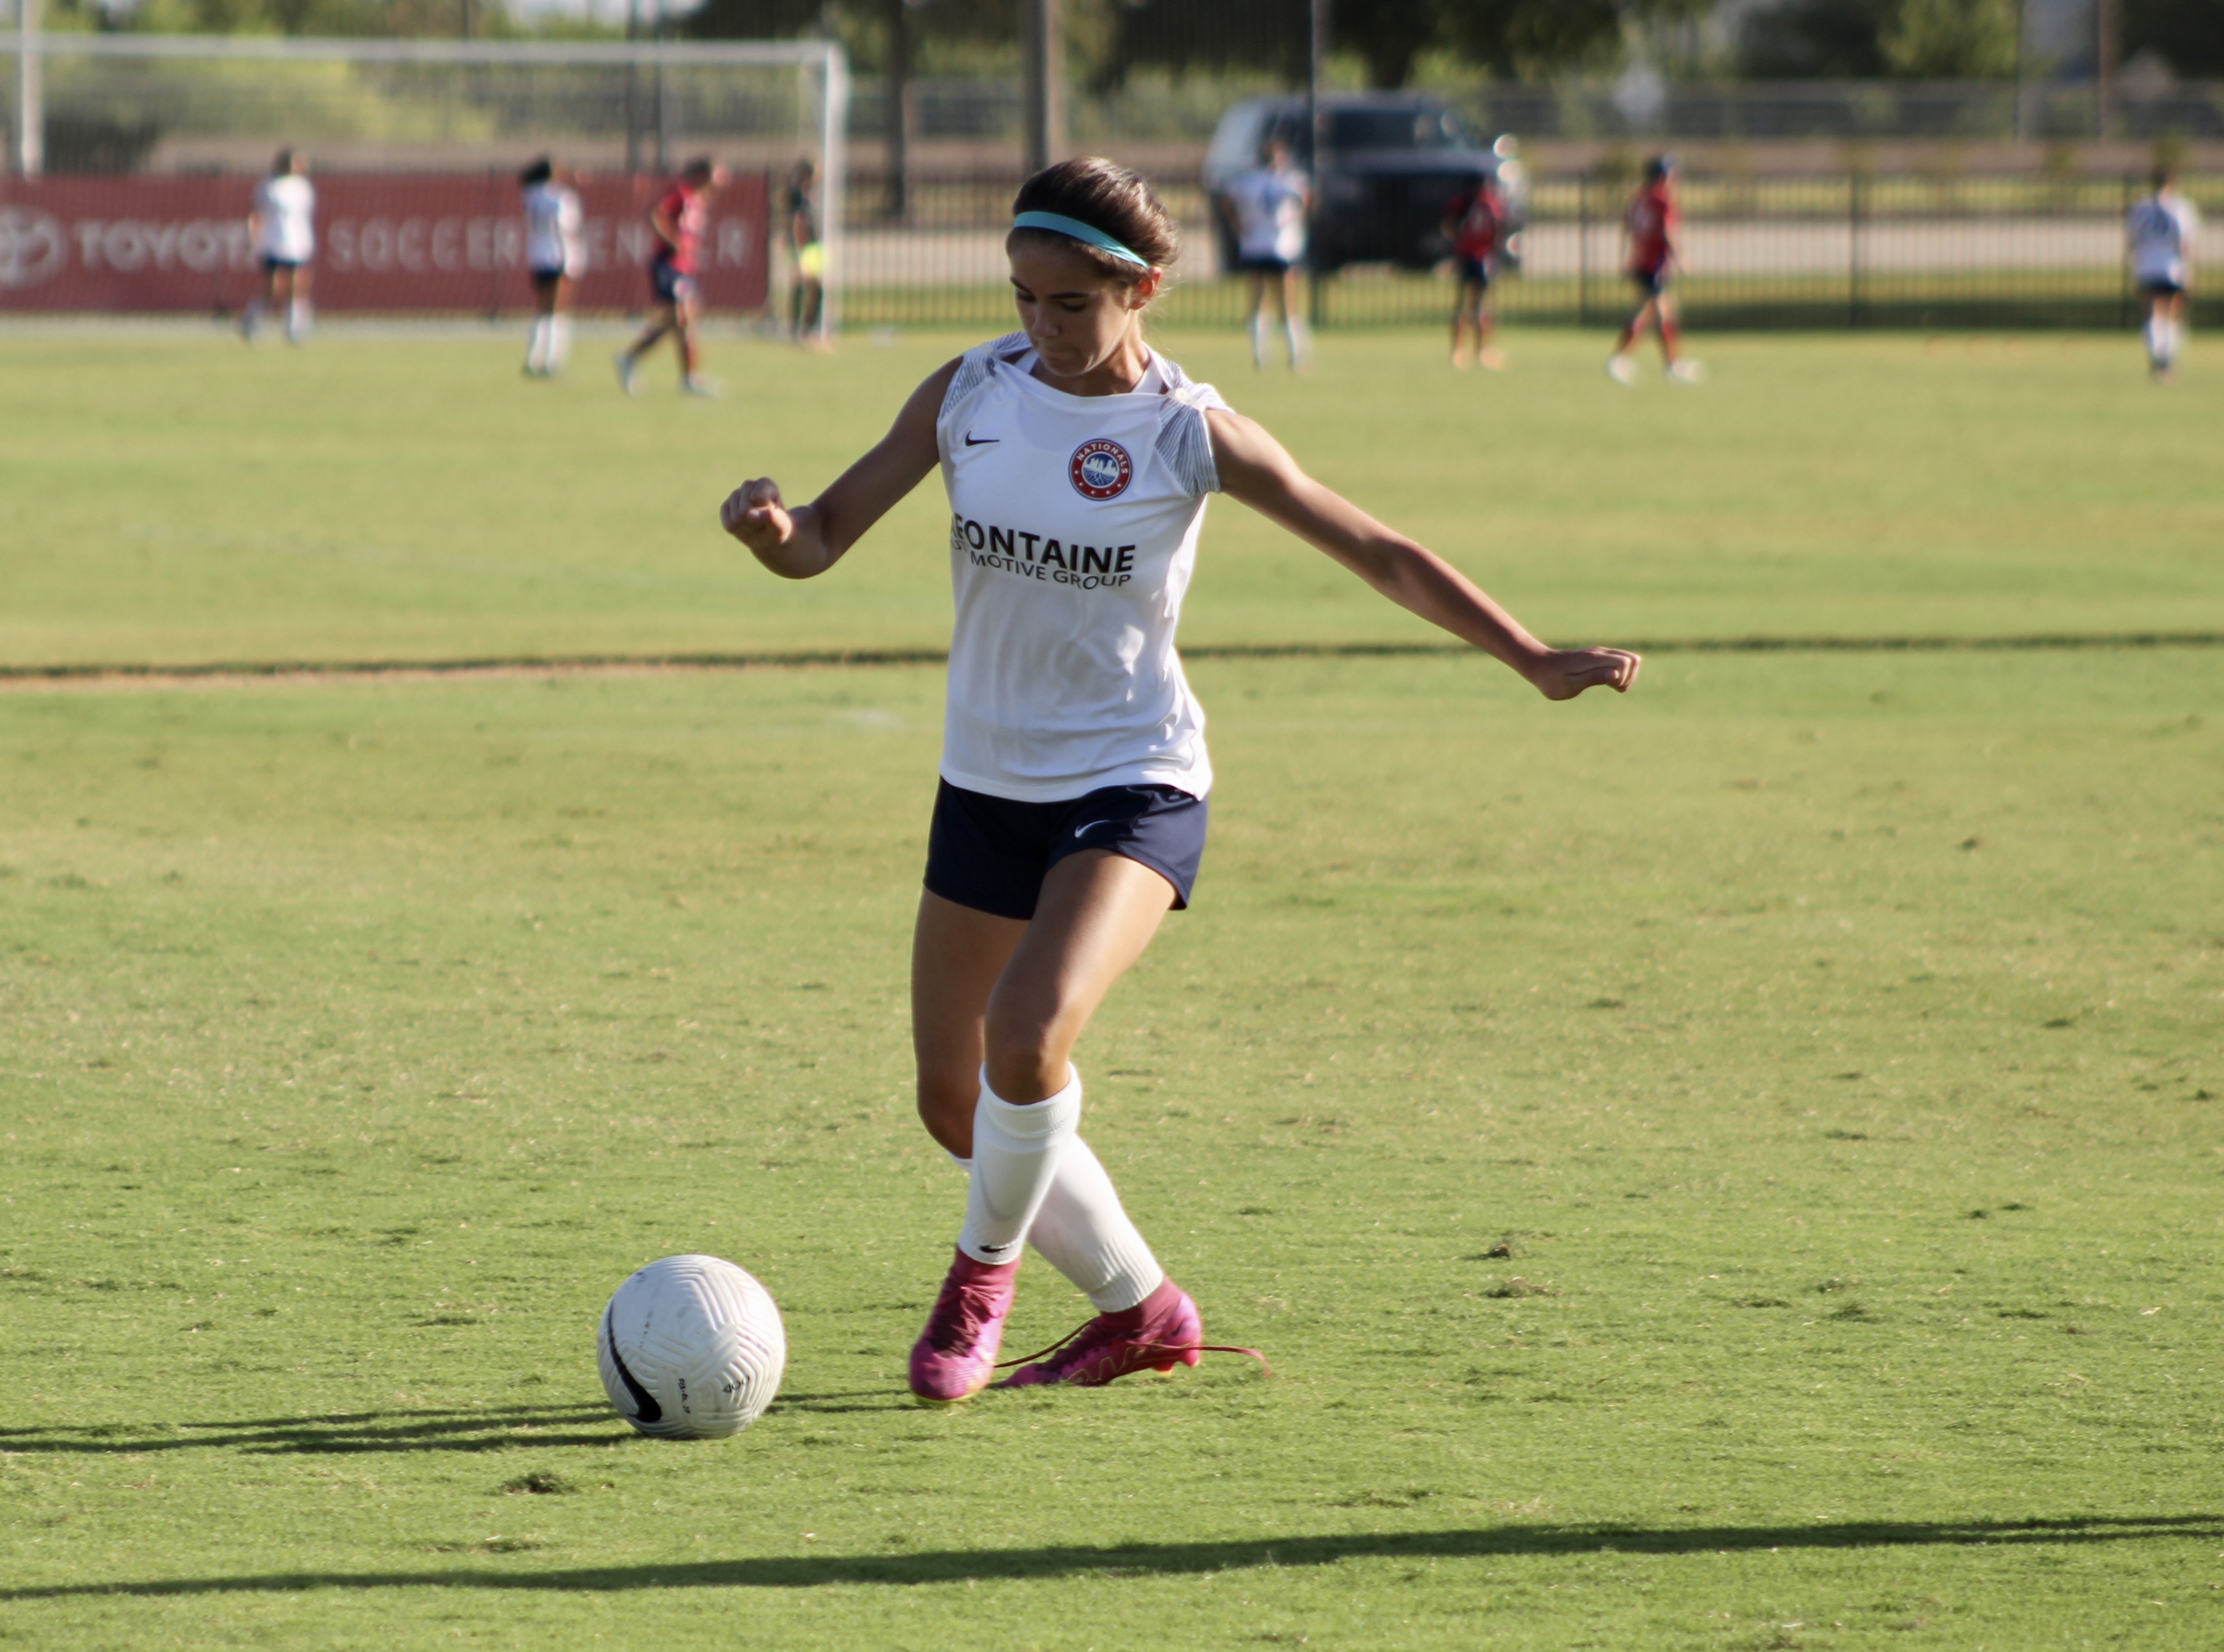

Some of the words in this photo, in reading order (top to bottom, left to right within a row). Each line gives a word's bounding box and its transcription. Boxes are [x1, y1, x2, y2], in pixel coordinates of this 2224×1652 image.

[78, 217, 256, 273] TOYOT
[326, 218, 523, 273] SOCCER
[1076, 443, 1128, 474] NATIONALS
[951, 511, 1136, 574] FONTAINE
[1052, 570, 1131, 590] GROUP
